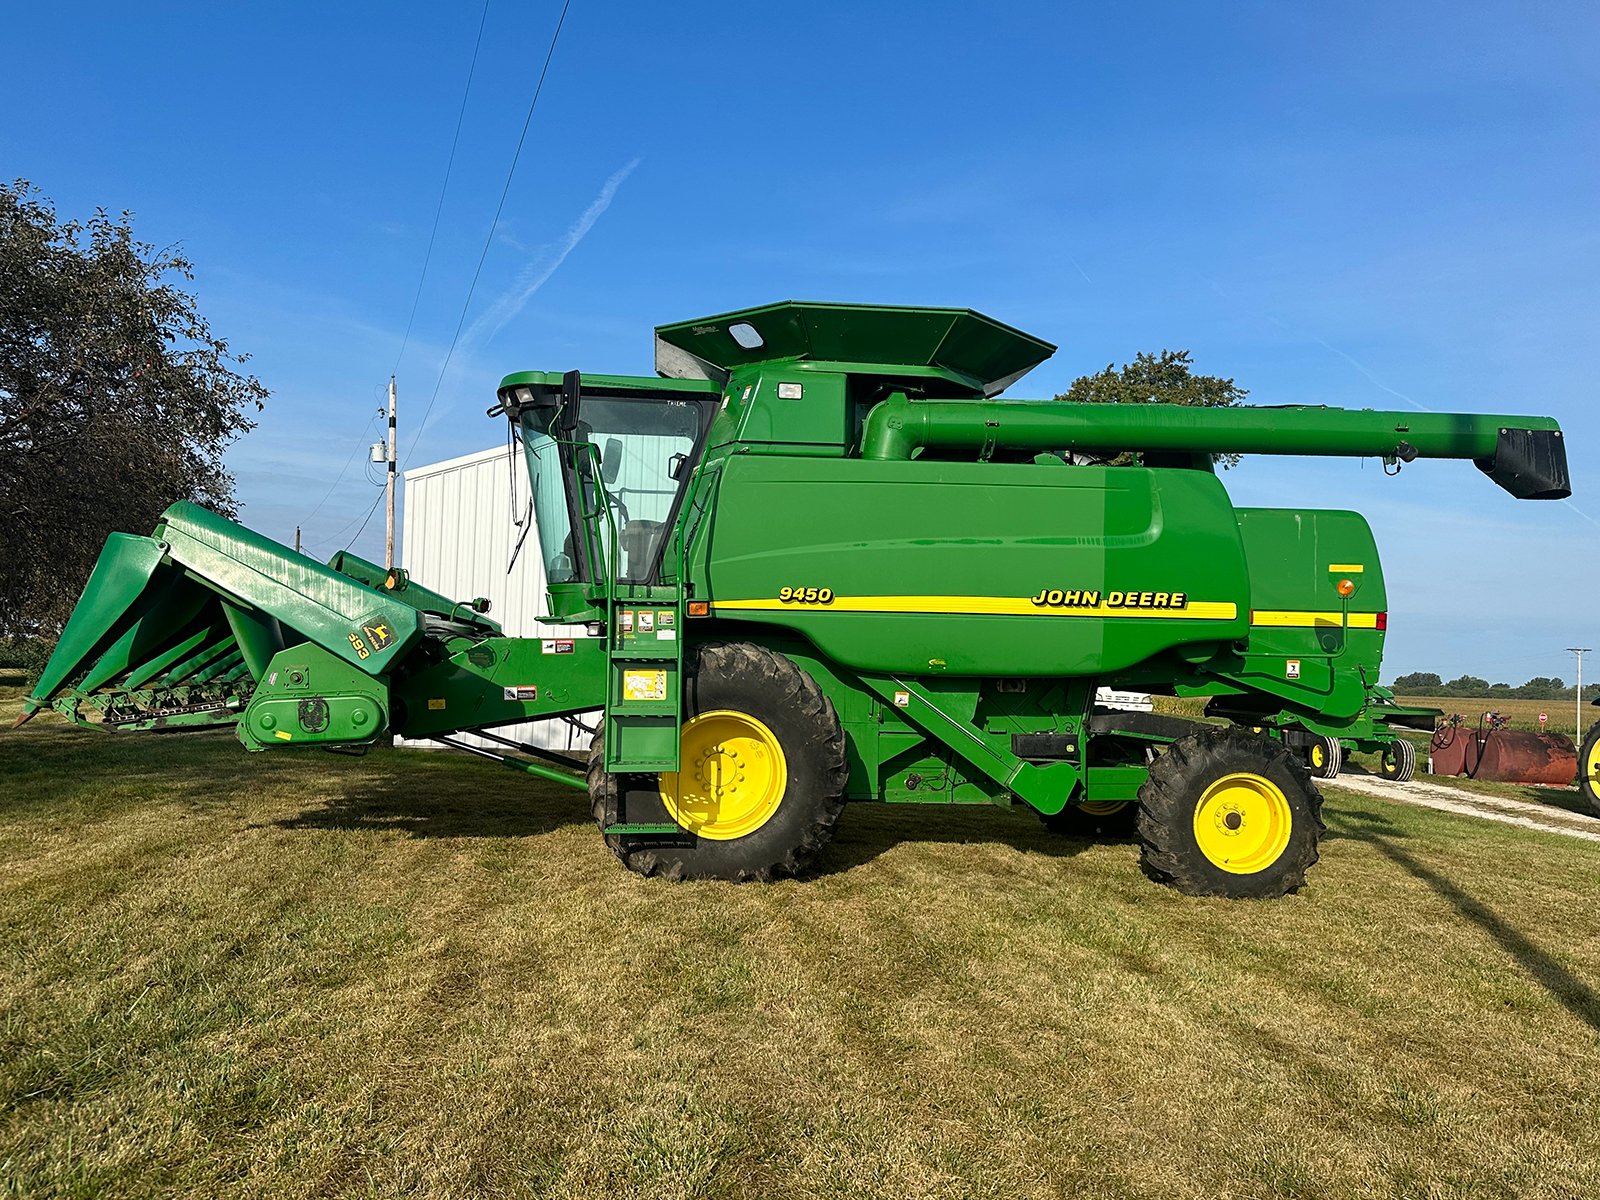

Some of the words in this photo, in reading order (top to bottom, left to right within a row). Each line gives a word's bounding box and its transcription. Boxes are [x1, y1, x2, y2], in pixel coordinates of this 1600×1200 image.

[779, 586, 834, 603] 9450
[1031, 589, 1100, 607] JOHN
[1107, 591, 1186, 609] DEERE
